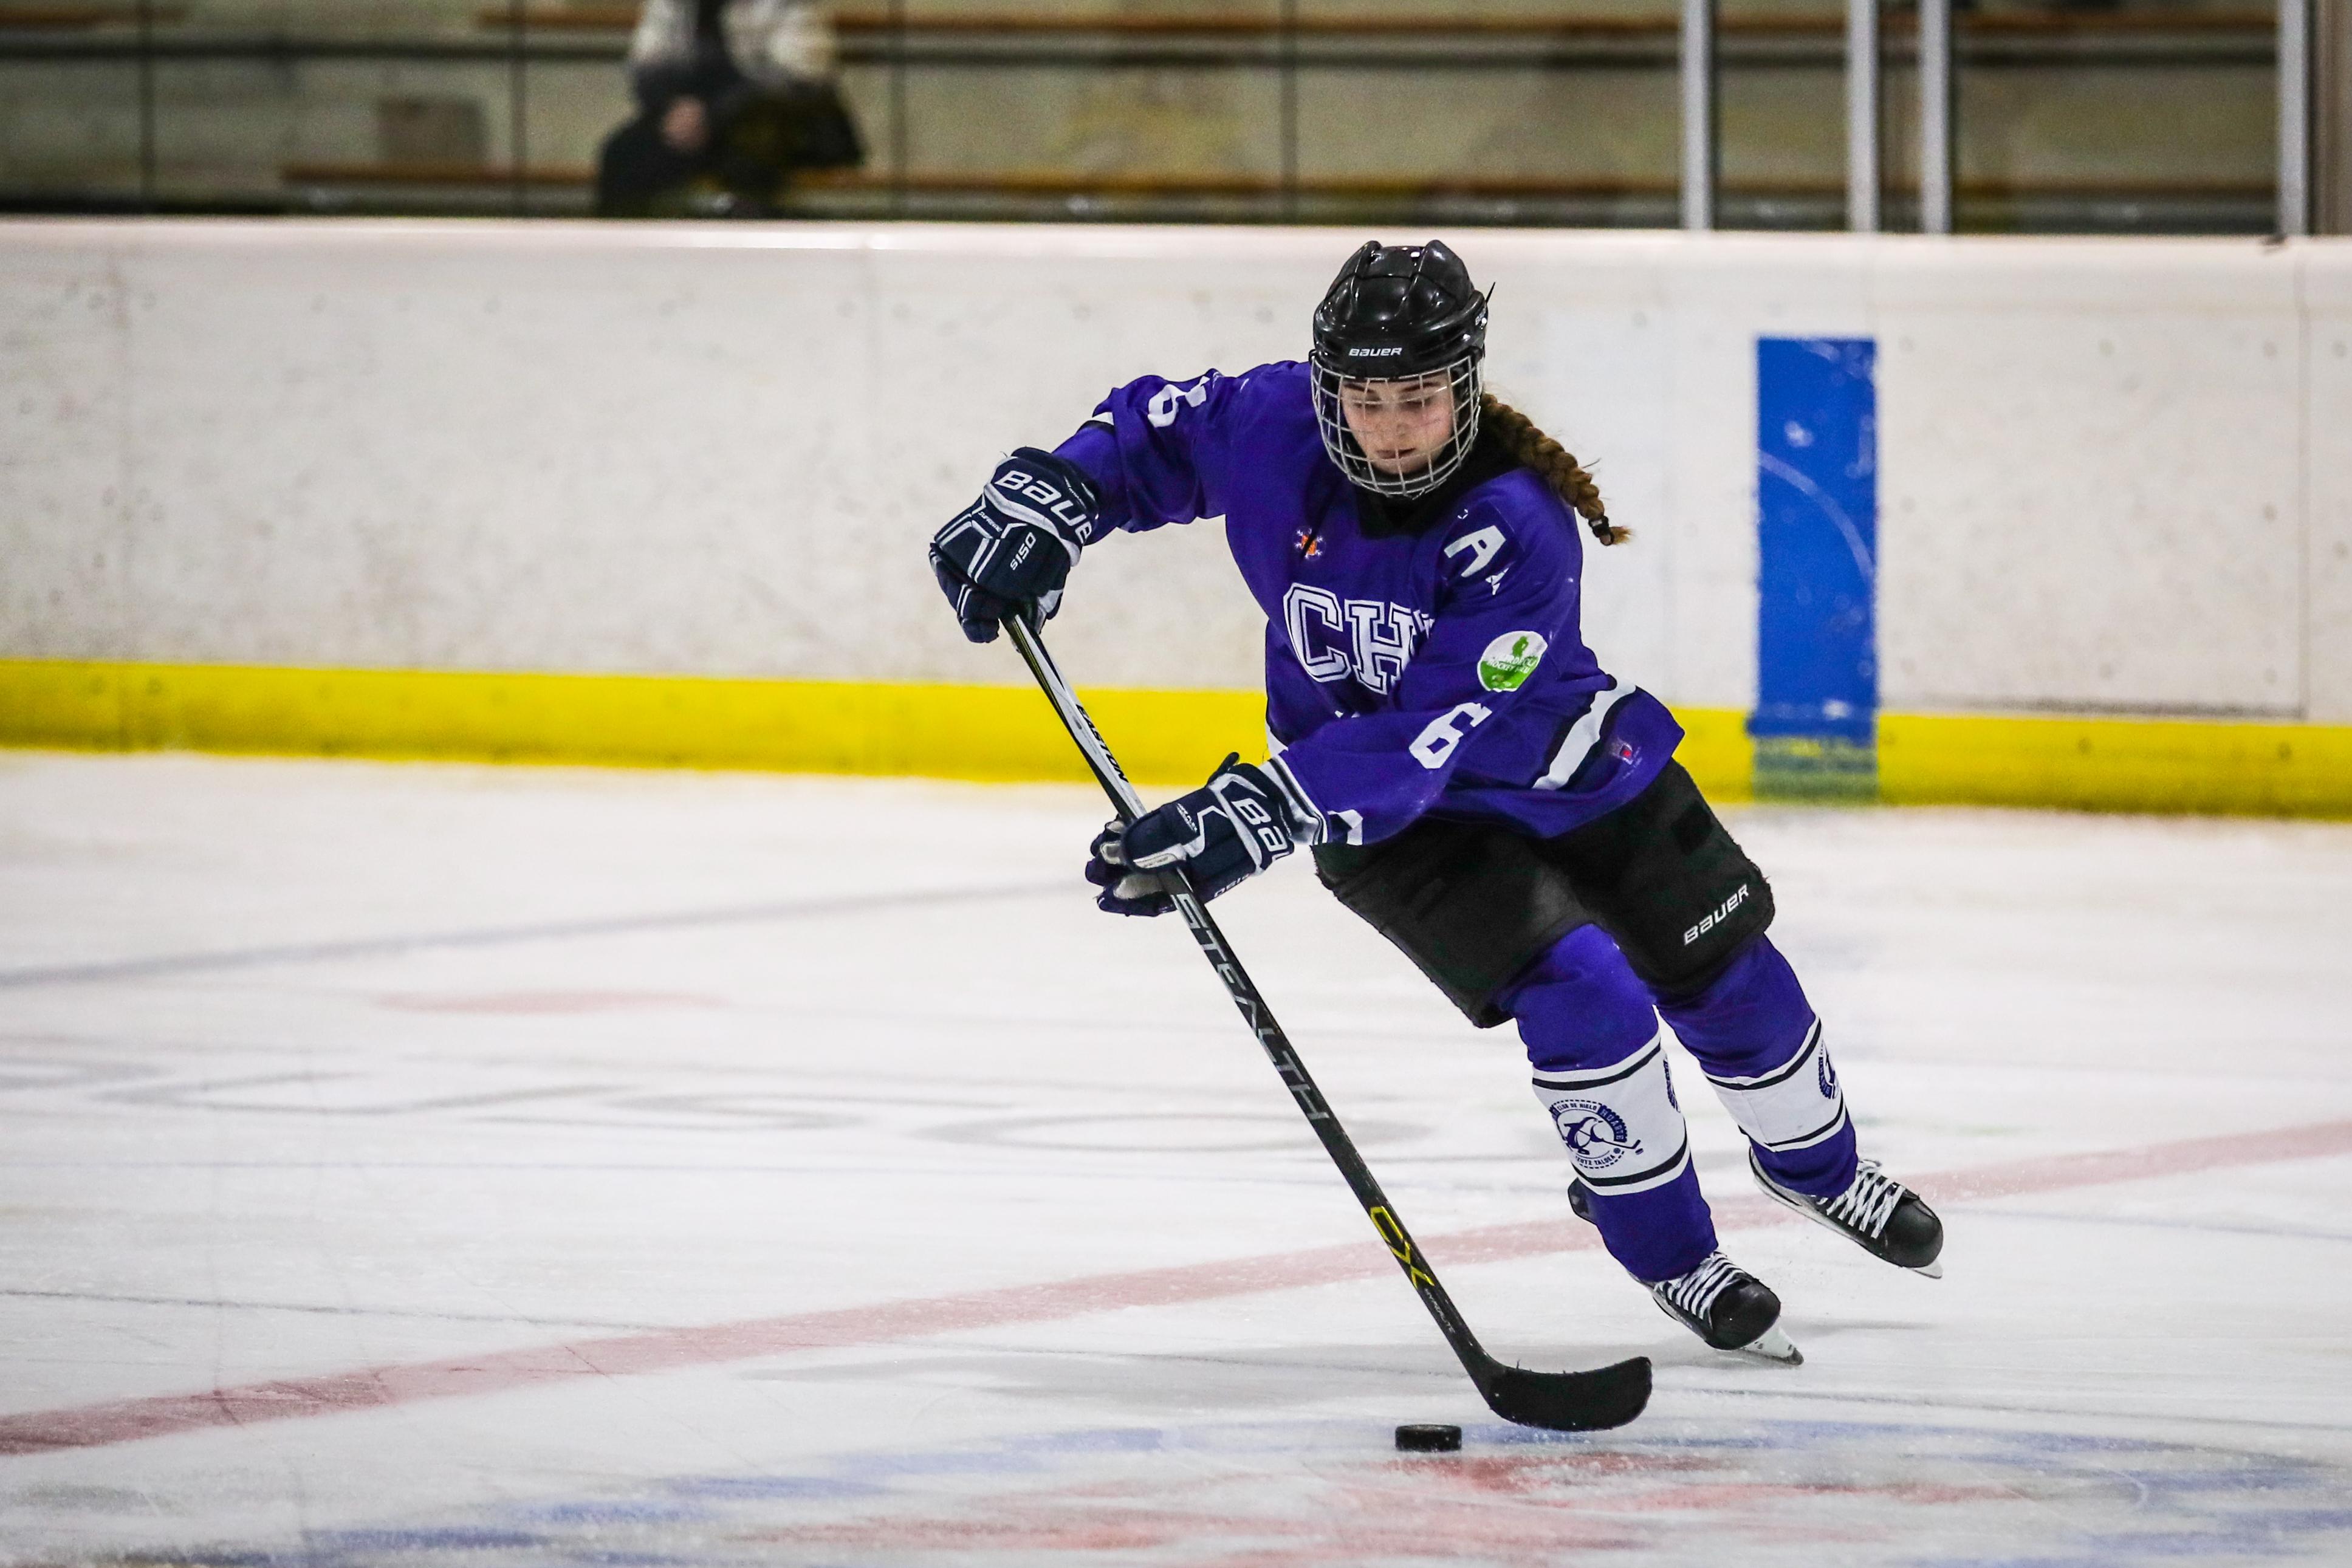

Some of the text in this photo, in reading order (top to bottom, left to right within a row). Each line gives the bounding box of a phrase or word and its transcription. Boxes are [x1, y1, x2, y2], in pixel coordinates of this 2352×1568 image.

[1349, 347, 1402, 357] BAUER
[1444, 525, 1507, 578] A
[1075, 704, 1129, 782] EASTON
[1408, 702, 1492, 770] 6
[1684, 883, 1749, 945] BAUER
[1170, 893, 1329, 1120] STEALTH
[1370, 1206, 1435, 1289] CX
